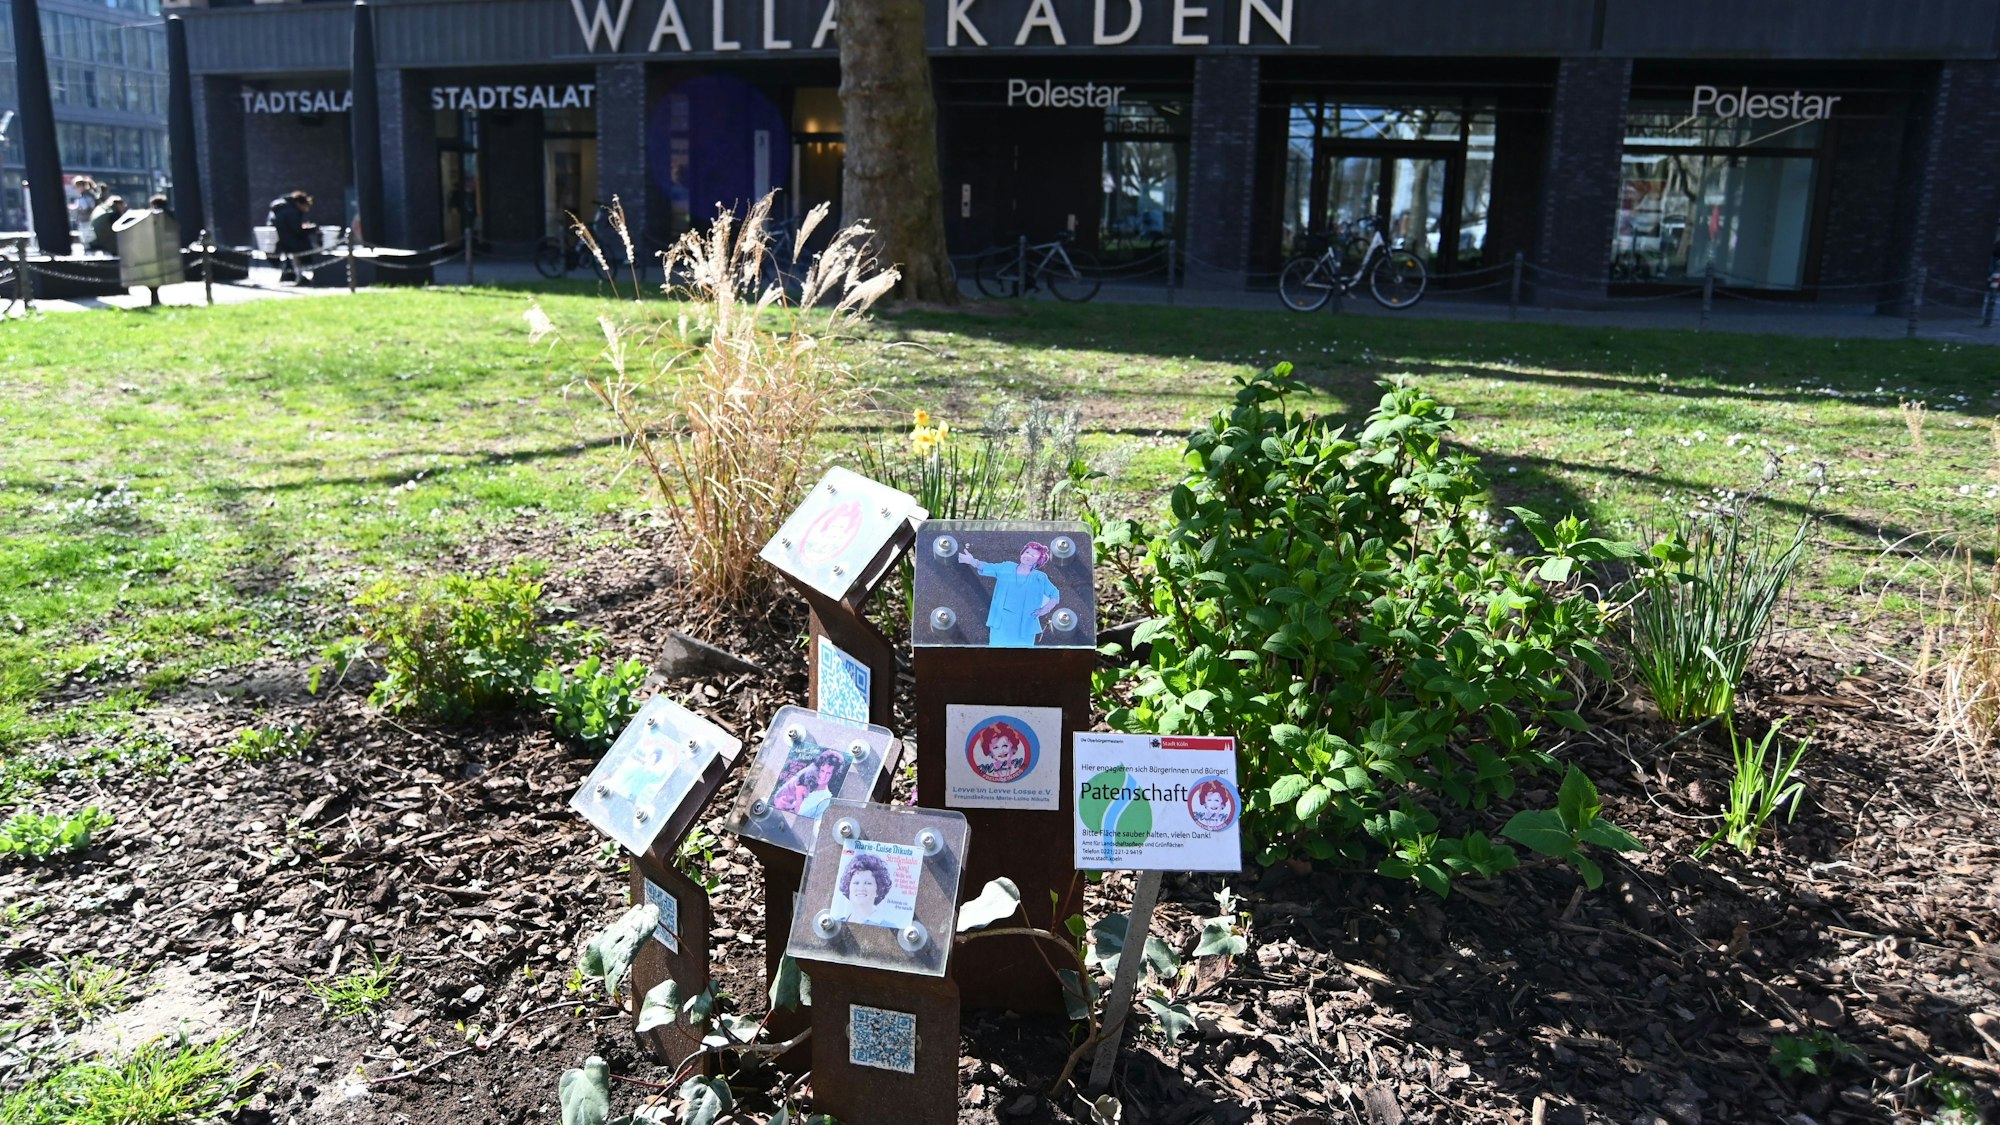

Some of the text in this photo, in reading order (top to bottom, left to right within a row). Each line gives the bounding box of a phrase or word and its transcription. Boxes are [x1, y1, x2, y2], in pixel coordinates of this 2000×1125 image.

[570, 0, 1294, 52] WALLAKADEN
[240, 89, 353, 113] TADTSALA
[431, 84, 596, 110] STADTSALAT
[1008, 78, 1125, 108] Polestar
[1692, 86, 1841, 120] Polestar
[1081, 764, 1229, 777] Hier engagieren sich Bürgerinnen und Bürger!
[988, 787, 1010, 795] Levve
[1013, 788, 1036, 796] Losse
[1081, 782, 1189, 802] Patenschaft
[1082, 828, 1211, 840] Bitte Fläche sauber halten, vielen Dank!
[1101, 840, 1144, 849] Landschaftspflege
